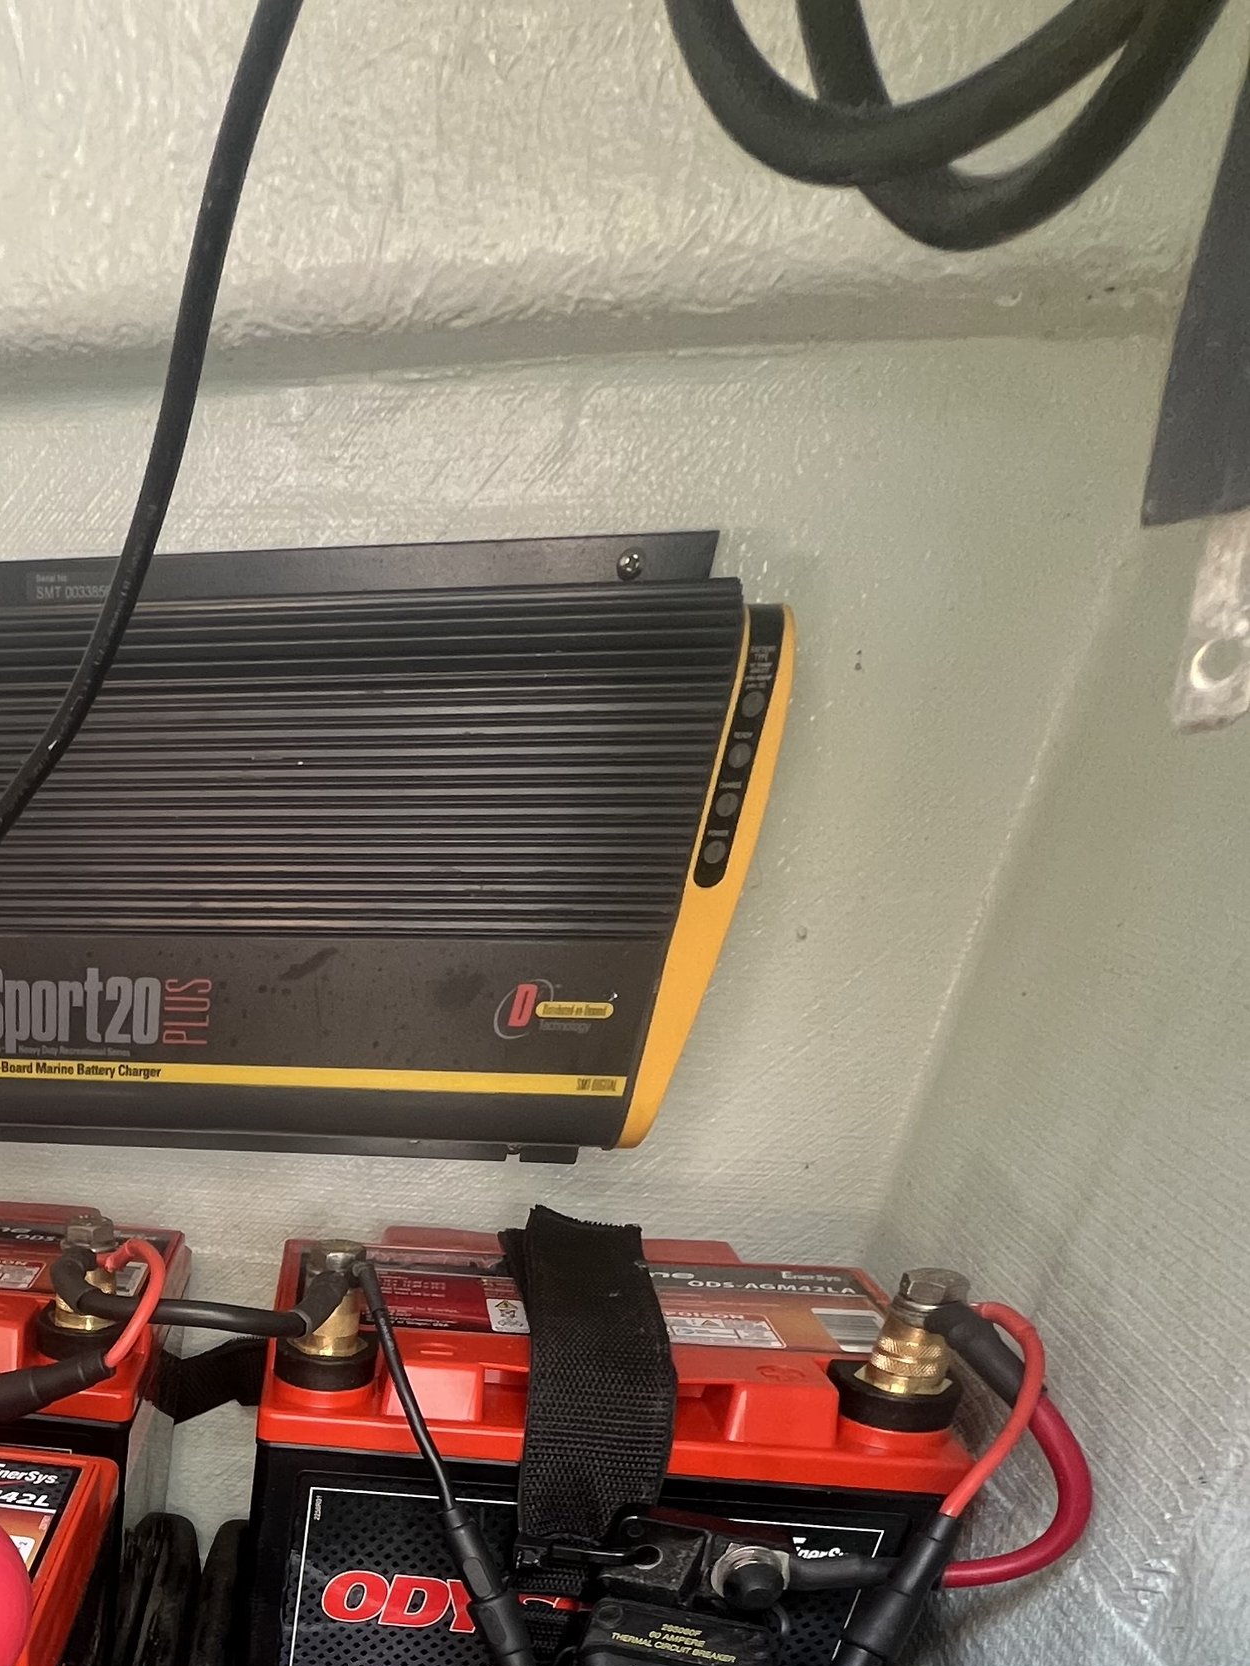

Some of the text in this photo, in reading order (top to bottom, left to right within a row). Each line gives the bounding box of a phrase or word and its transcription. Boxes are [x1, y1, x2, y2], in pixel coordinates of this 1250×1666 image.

[36, 586, 62, 599] SMT
[163, 978, 213, 1045] PLUS
[539, 1019, 591, 1034] Technology
[35, 1062, 74, 1075] Marine
[77, 1062, 116, 1077] Battery
[118, 1063, 161, 1079] Charger
[781, 1270, 842, 1283] EnerSys
[687, 1279, 857, 1295] ODS-AGM42LA
[648, 1630, 706, 1648] 60 AMPERE
[611, 1631, 737, 1664] THERMAL CIRCUIT BREAKER
